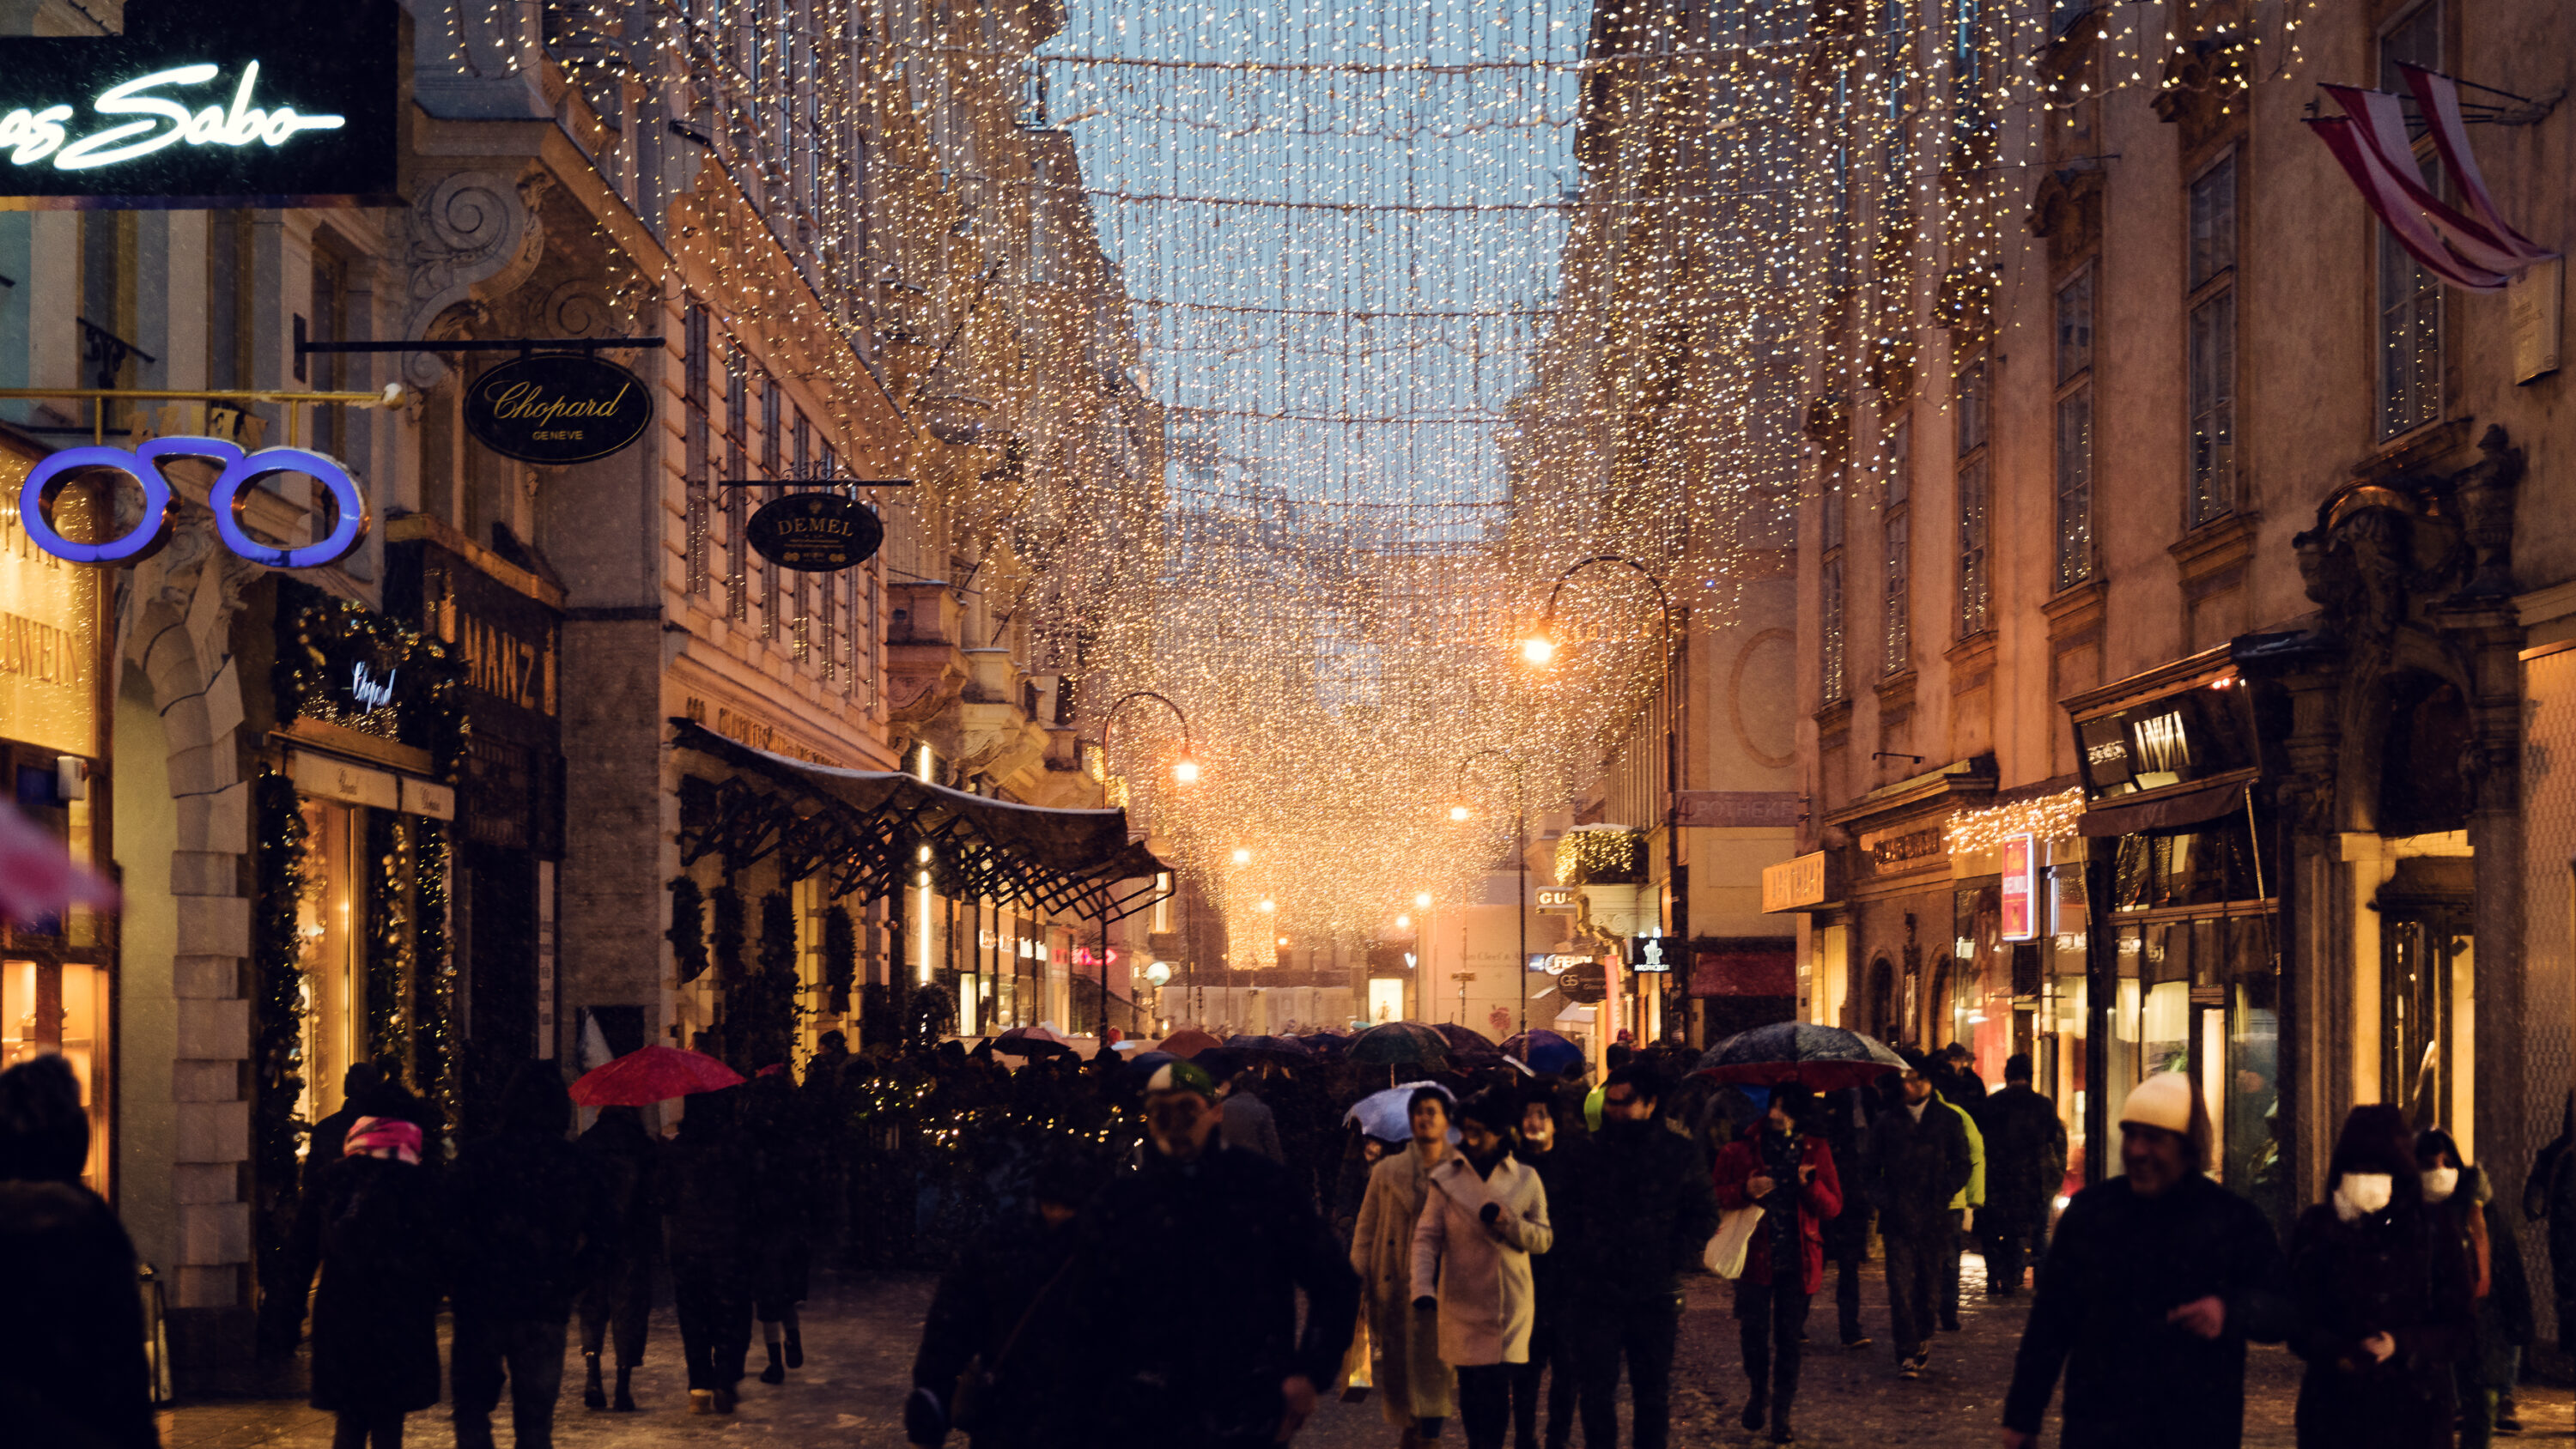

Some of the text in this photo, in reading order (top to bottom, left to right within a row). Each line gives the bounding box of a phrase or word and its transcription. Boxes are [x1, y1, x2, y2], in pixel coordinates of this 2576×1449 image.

[53, 59, 345, 171] Sabo
[483, 380, 631, 427] Chopard
[532, 430, 585, 441] GENEVE
[777, 517, 854, 537] DEMEL
[464, 613, 536, 710] MANZ
[1539, 892, 1572, 905] GU
